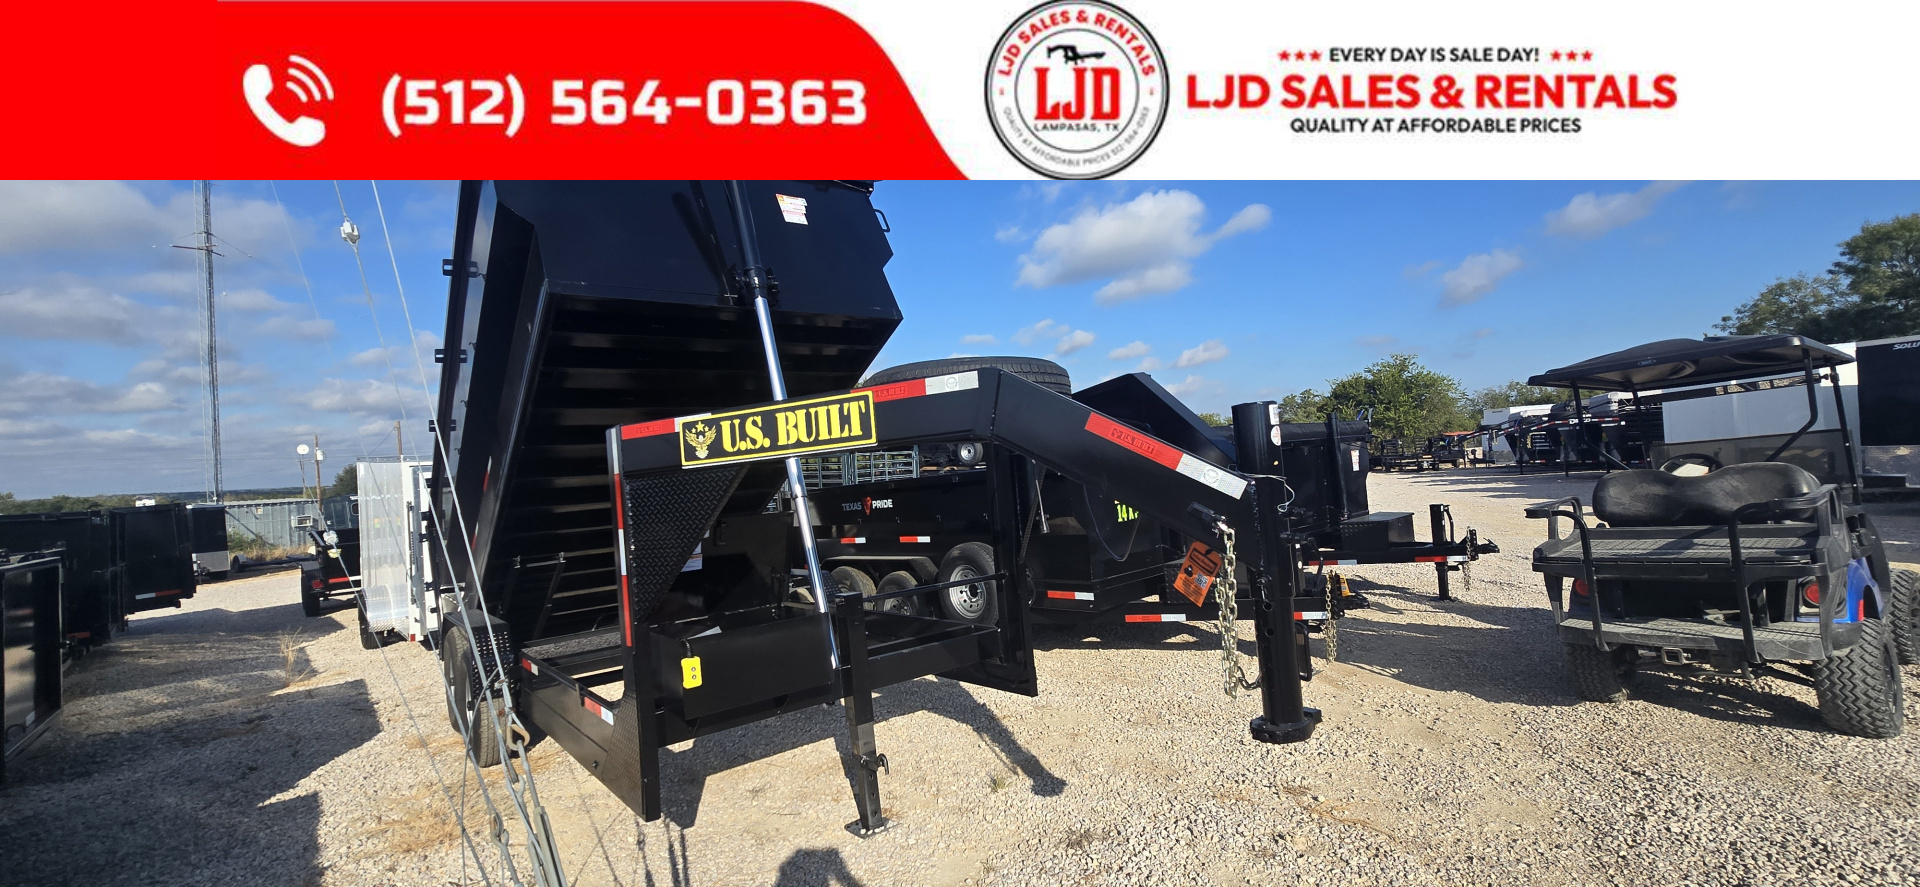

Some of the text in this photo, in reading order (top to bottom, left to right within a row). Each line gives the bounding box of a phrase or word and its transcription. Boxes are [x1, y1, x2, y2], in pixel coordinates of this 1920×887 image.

[720, 400, 866, 452] U.S. BUILT
[842, 499, 893, 511] TEXAS PRIDE
